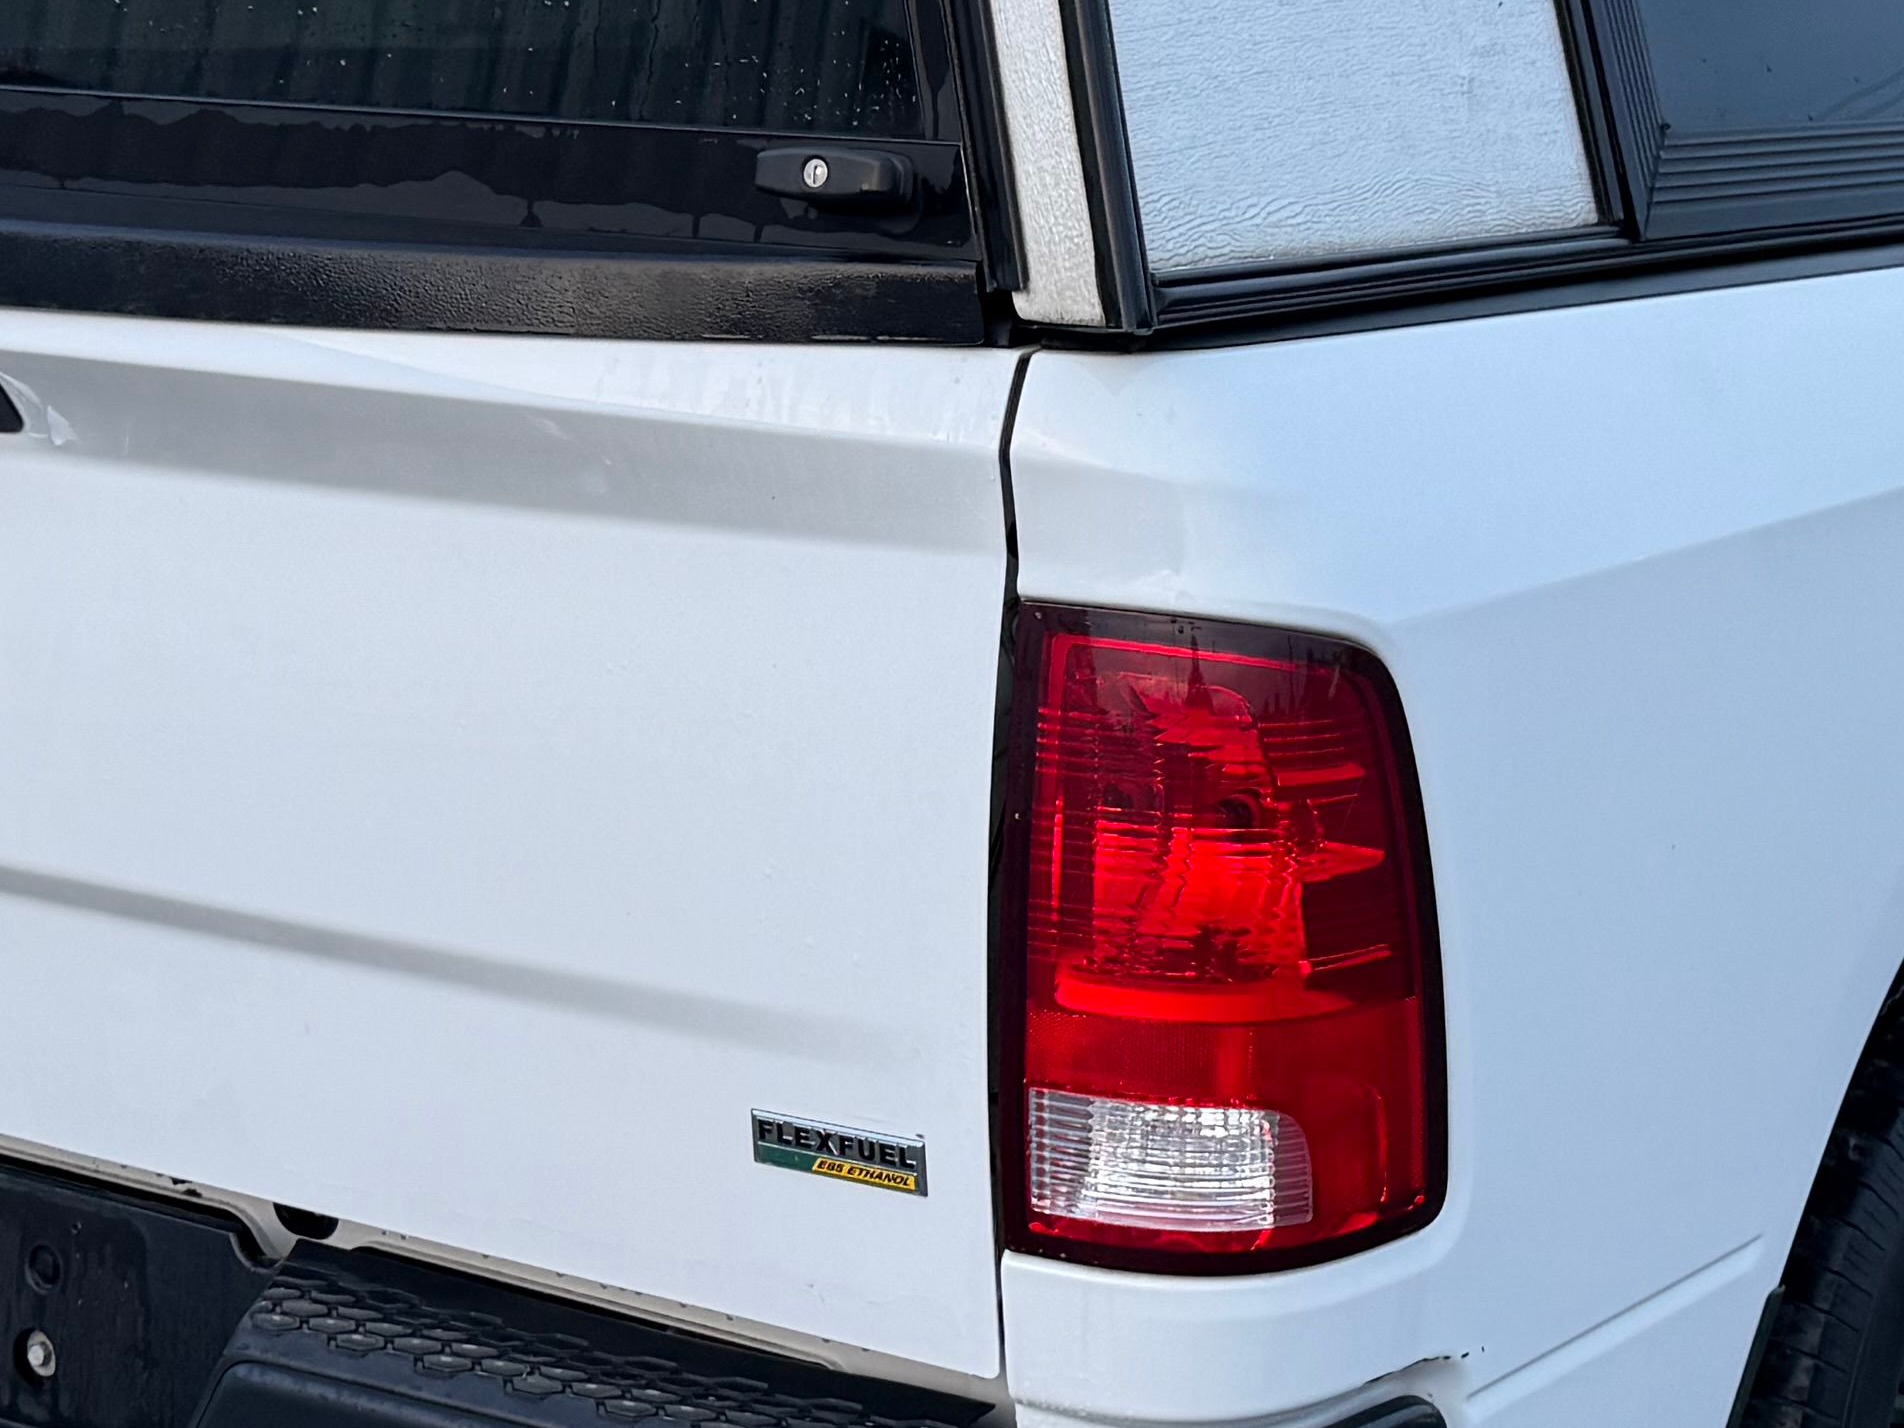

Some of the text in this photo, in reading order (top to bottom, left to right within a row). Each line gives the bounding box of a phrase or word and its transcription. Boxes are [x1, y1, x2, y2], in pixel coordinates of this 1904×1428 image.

[756, 1117, 917, 1170] FLEXFUEL
[816, 1159, 912, 1187] E85 ETHANOL
